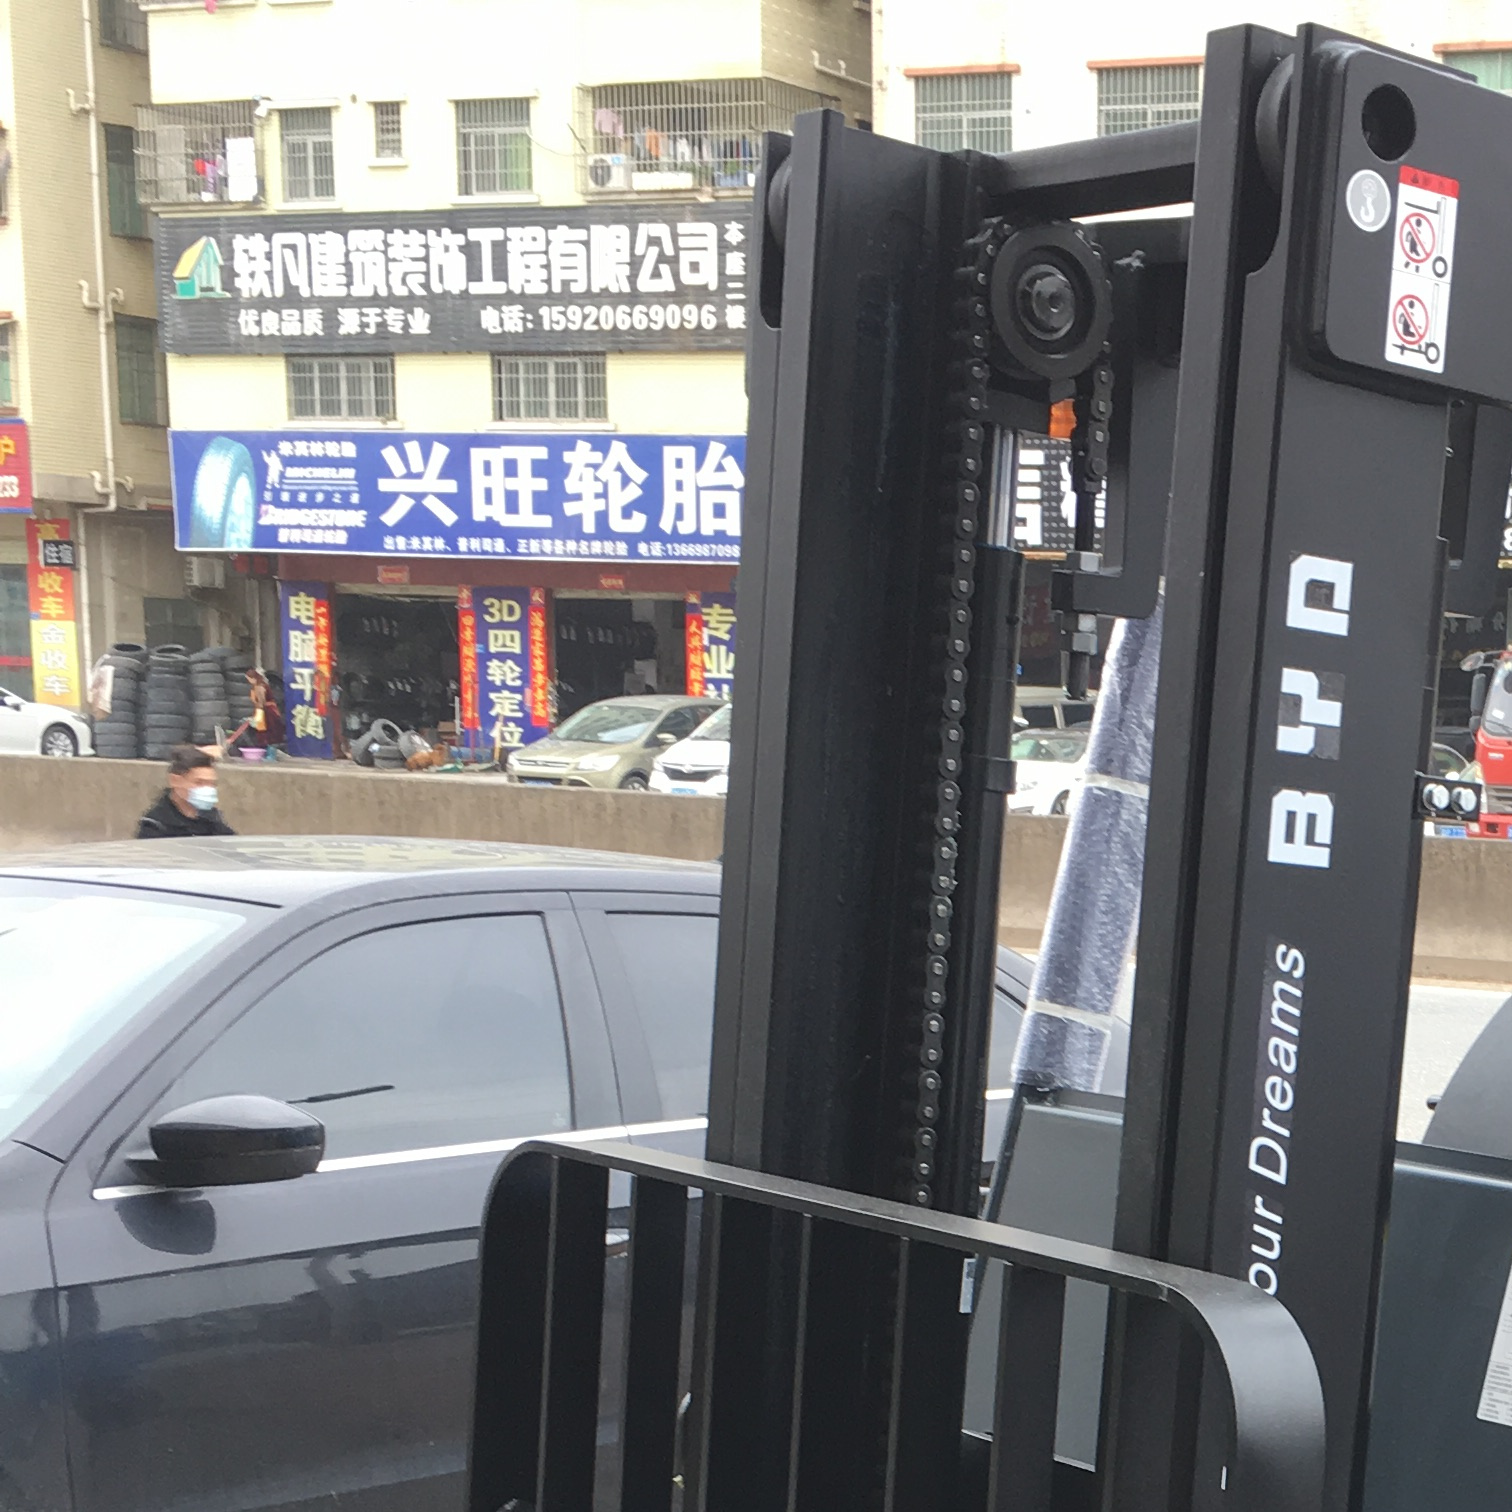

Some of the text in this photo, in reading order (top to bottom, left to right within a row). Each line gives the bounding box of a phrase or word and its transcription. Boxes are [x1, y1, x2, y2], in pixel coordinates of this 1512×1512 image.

[238, 308, 324, 336] 优良品质
[337, 307, 431, 335] 源于专业
[377, 440, 745, 537] 兴旺轮胎
[1267, 554, 1354, 868] BYD
[1247, 943, 1306, 1297] our Dreams
